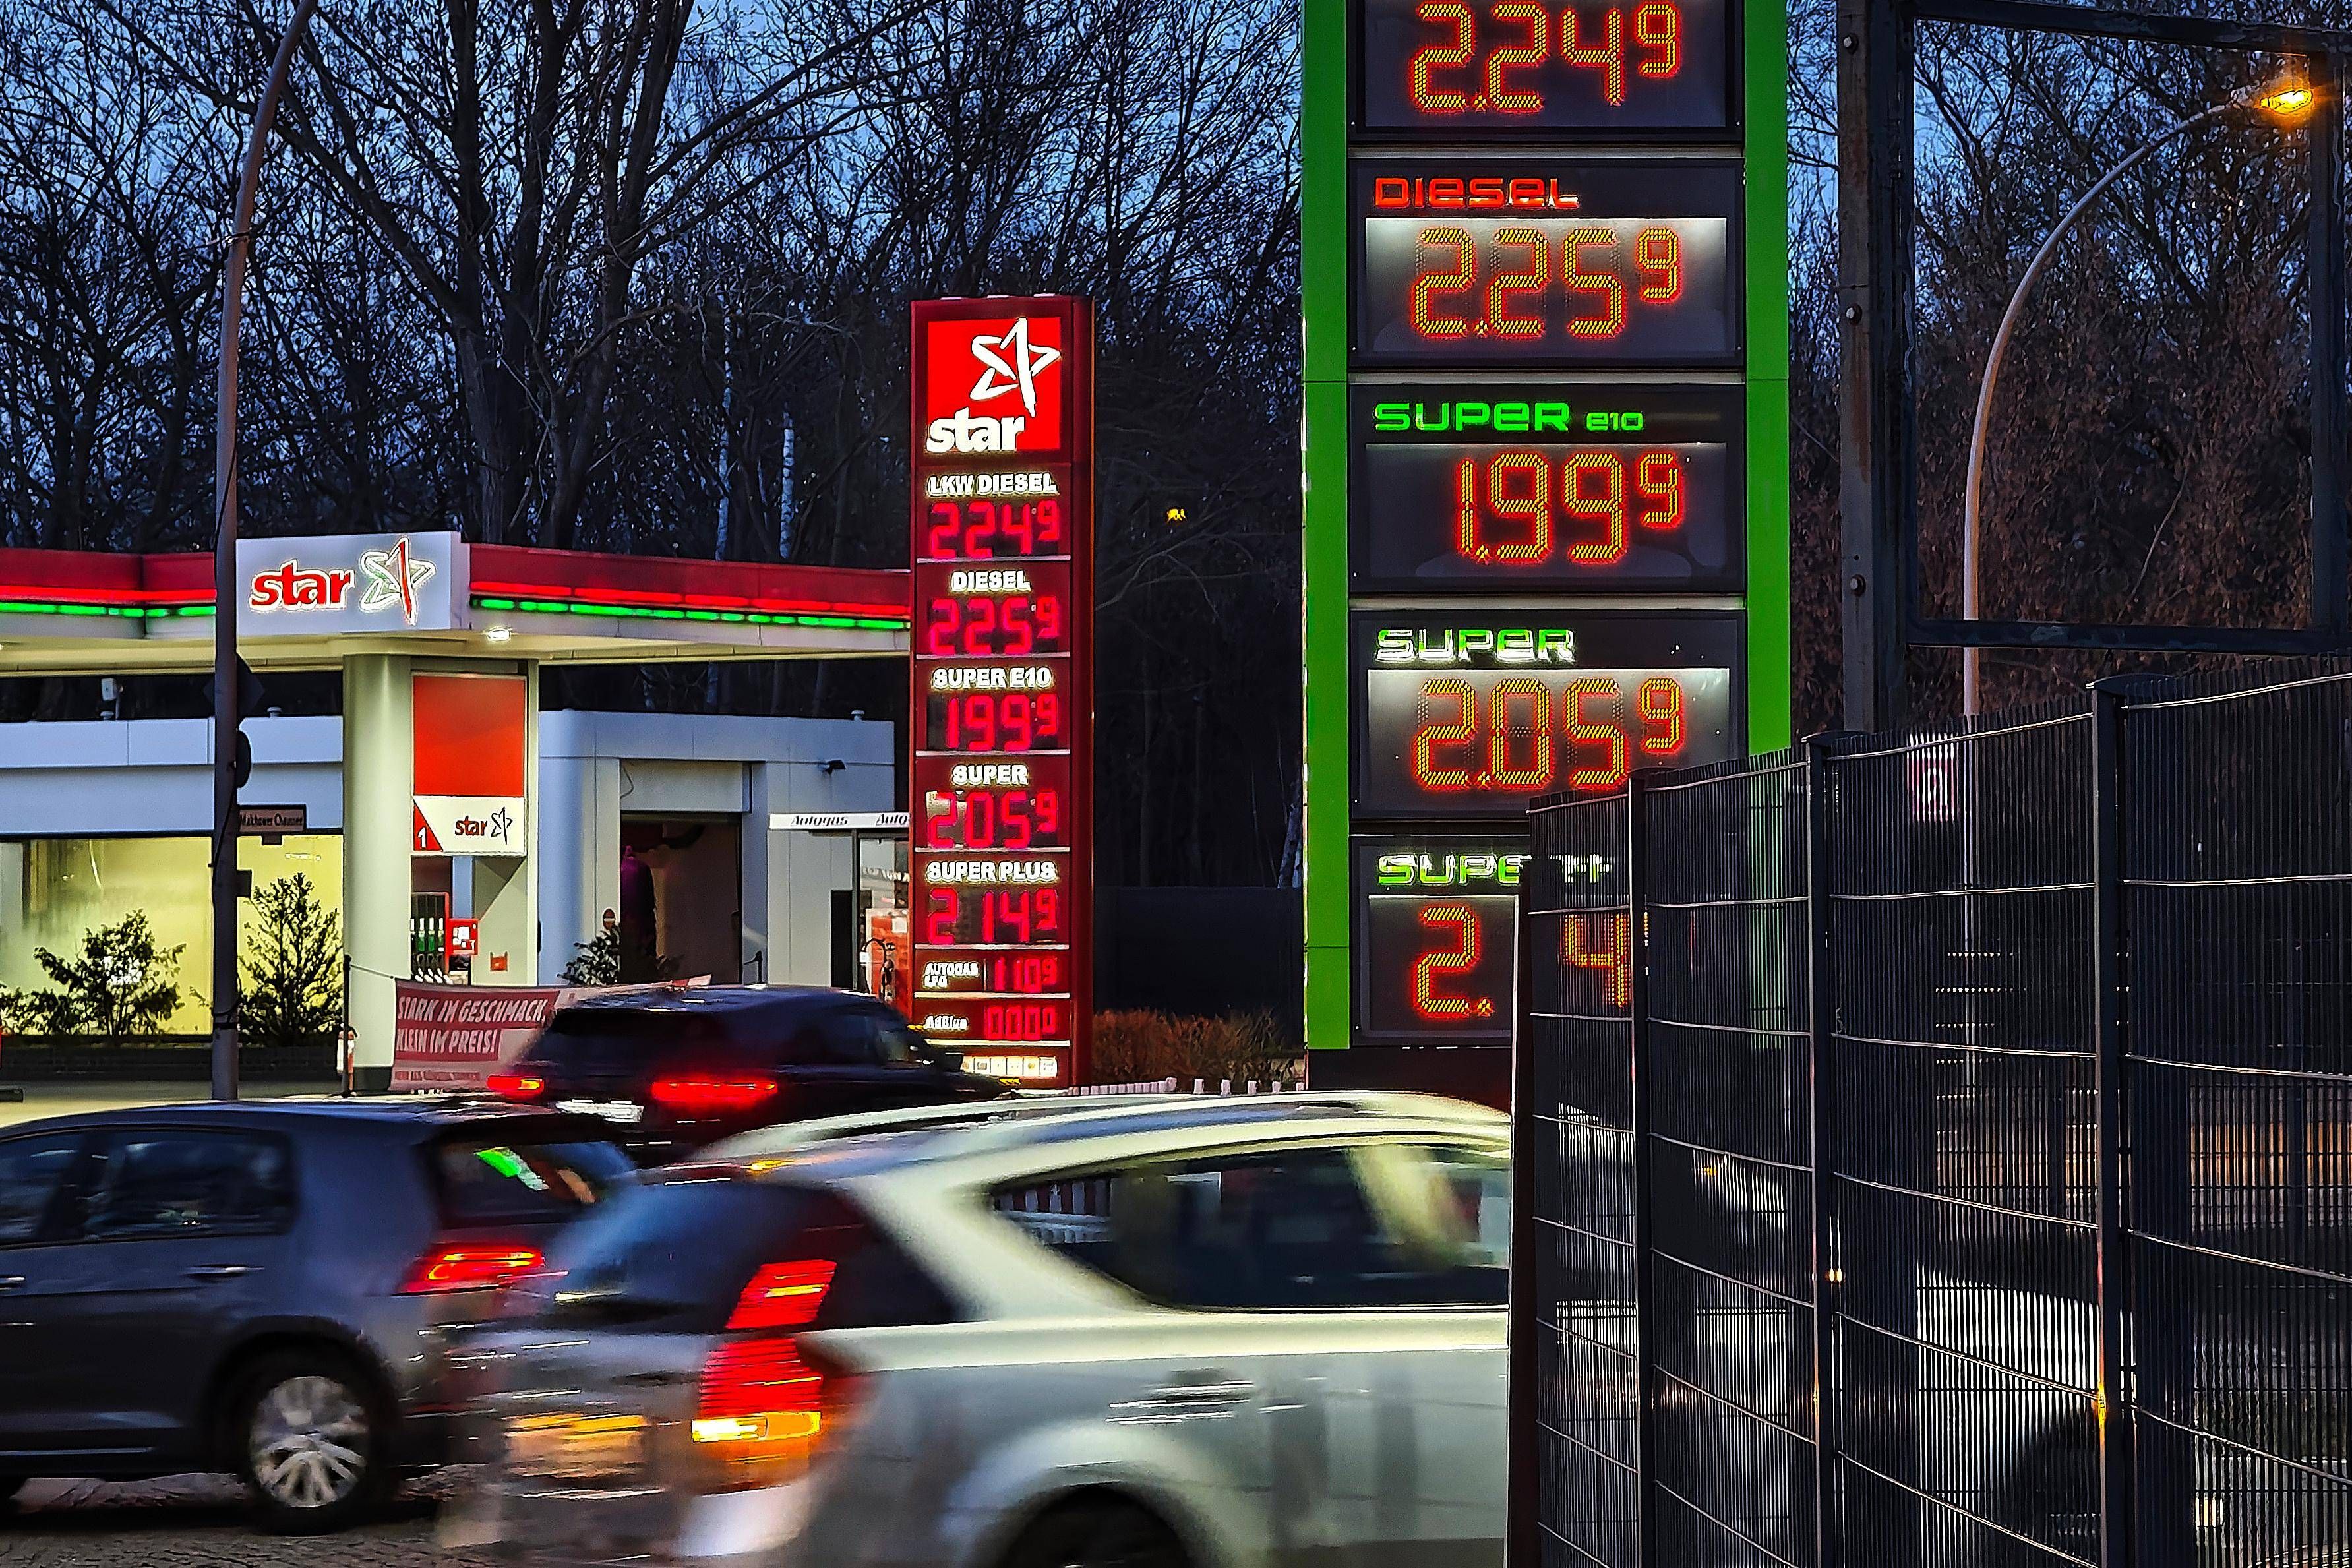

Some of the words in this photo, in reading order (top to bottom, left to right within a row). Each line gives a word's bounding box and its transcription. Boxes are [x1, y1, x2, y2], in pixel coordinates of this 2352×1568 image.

[926, 407, 1025, 453] star
[927, 474, 974, 497] LKW
[977, 473, 1058, 495] DIESEL
[250, 560, 354, 611] star
[951, 570, 1032, 593] DIESEL
[932, 667, 1007, 690] SUPER
[1009, 667, 1054, 688] E10
[951, 764, 1029, 786] SUPER
[454, 815, 488, 836] star
[791, 815, 848, 827] Autogas
[417, 826, 427, 849] 1
[926, 861, 996, 883] SUPER
[998, 860, 1058, 882] PLUS
[398, 996, 438, 1022] STARK
[395, 1027, 428, 1053] KLEIN
[429, 1028, 450, 1054] IM
[448, 1029, 498, 1054] PREIS!
